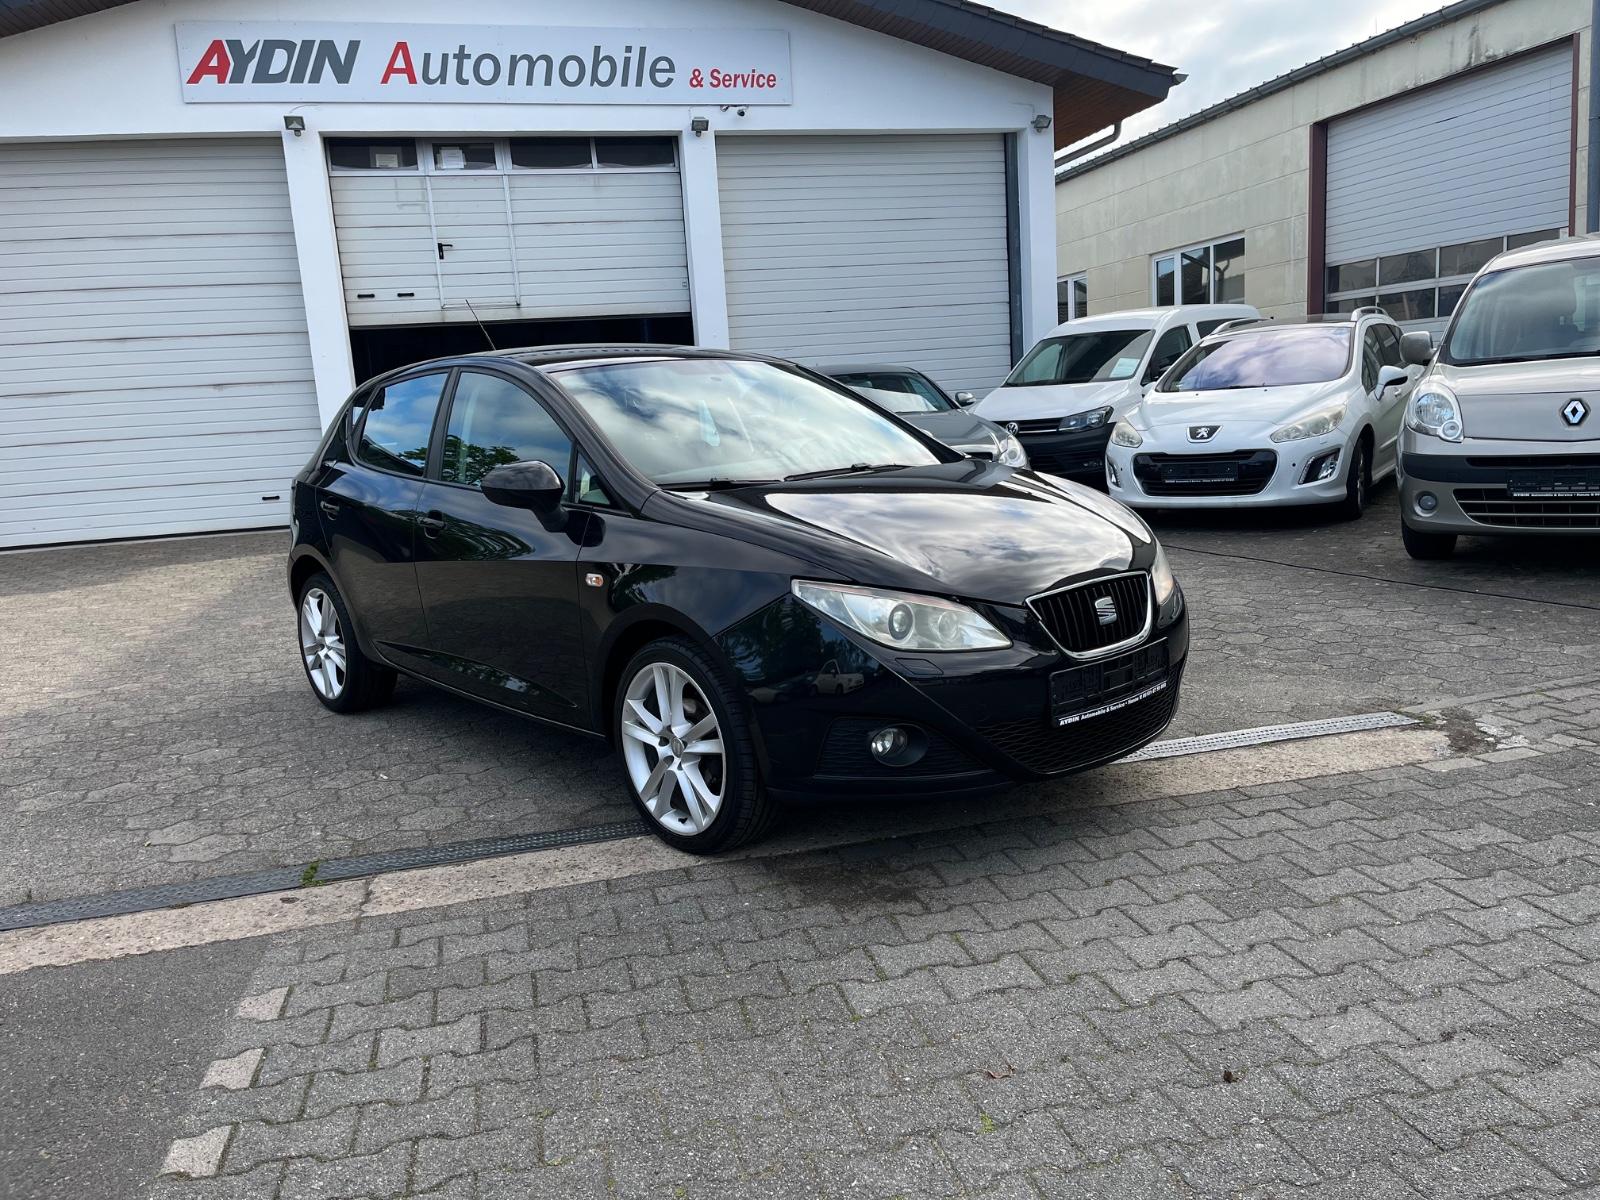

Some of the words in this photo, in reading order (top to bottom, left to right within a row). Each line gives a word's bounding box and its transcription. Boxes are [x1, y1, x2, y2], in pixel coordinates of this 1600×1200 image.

[186, 39, 361, 84] AYDIN
[381, 41, 676, 88] Automobile
[690, 69, 704, 88] &
[709, 68, 777, 89] Service
